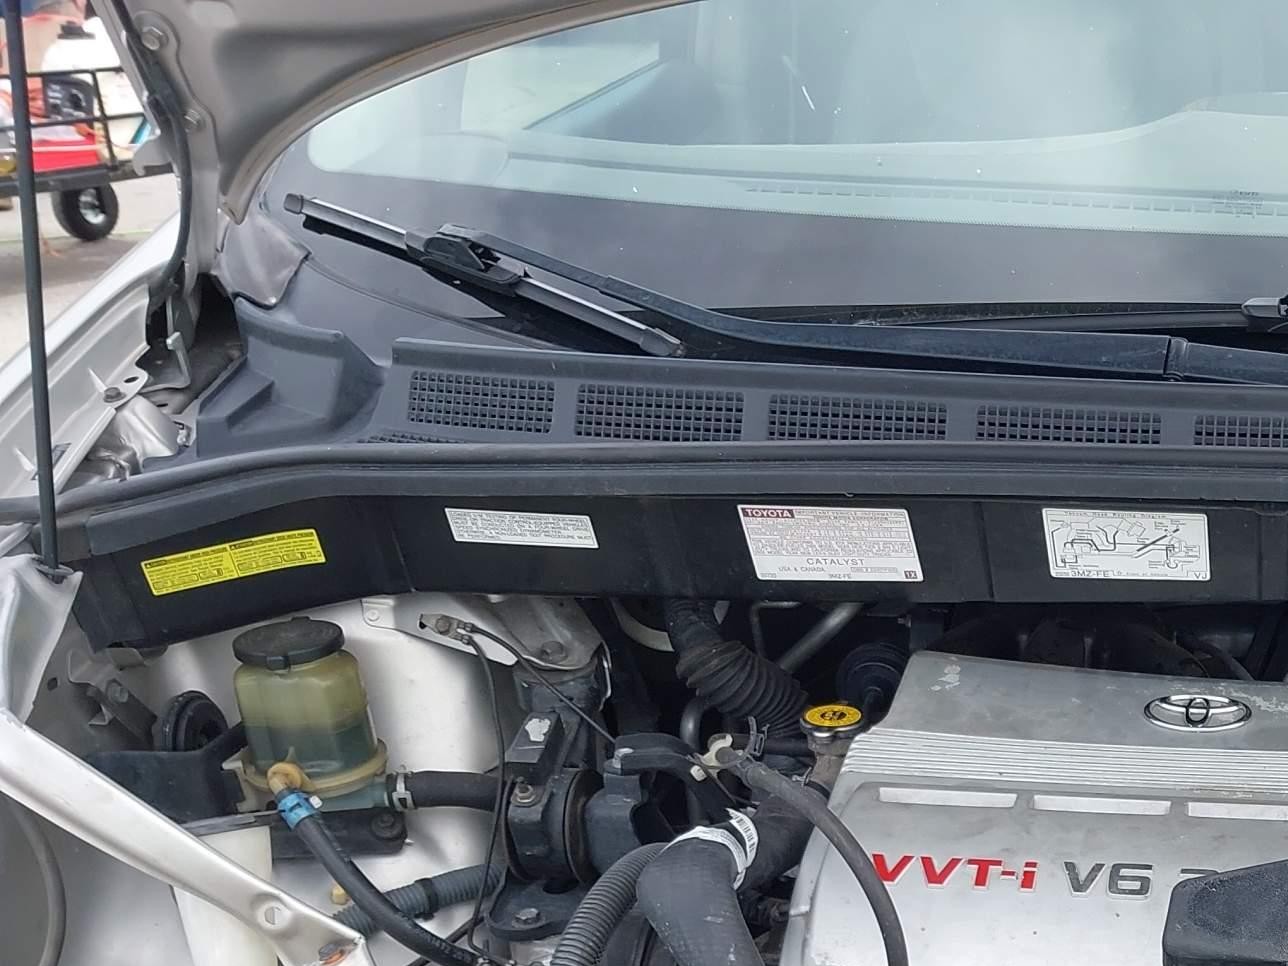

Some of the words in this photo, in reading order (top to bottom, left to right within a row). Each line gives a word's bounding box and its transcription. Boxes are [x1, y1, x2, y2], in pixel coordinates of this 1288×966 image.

[745, 508, 793, 518] TOYOTA
[806, 558, 865, 566] CATALYST
[1071, 569, 1110, 578] 3MZ-FE
[871, 853, 1040, 892] VVT-i
[1063, 860, 1155, 899] V6
